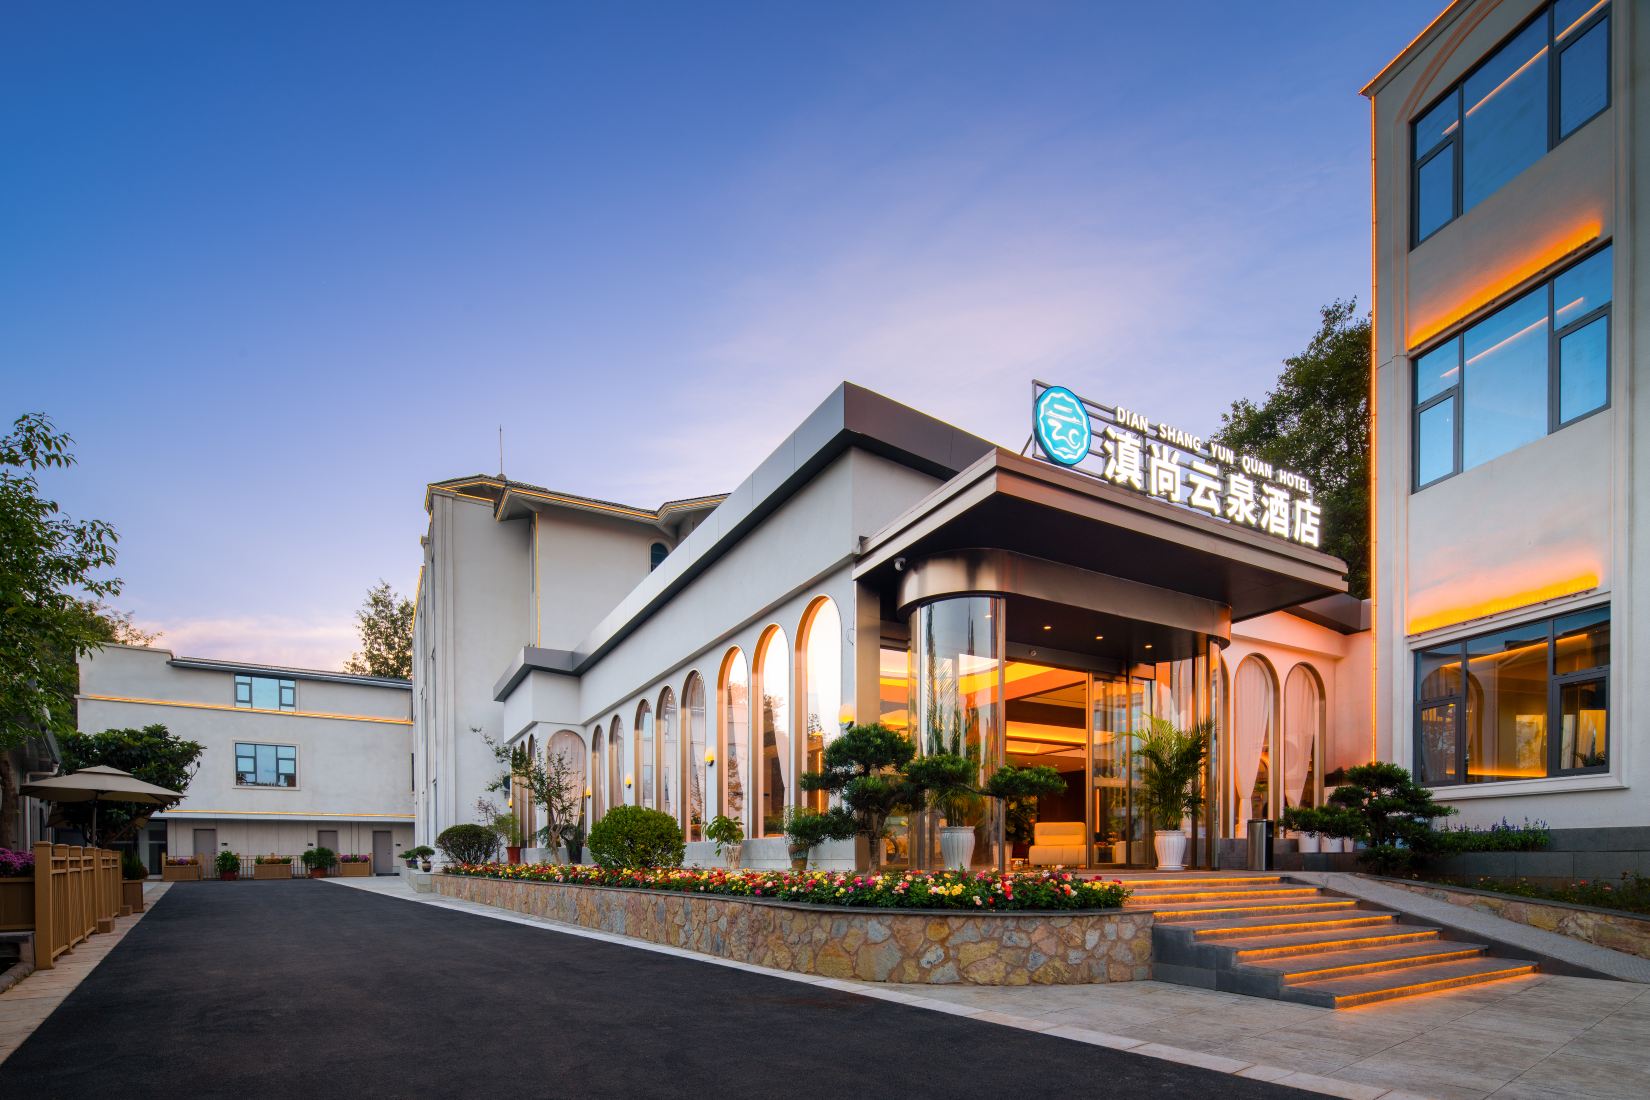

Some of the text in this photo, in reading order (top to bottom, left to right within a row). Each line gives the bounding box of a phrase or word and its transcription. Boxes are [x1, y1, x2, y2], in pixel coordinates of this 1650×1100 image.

[1102, 426, 1321, 547] 滇尚云泉酒店
[1116, 406, 1311, 493] DIAN SHANG YUN QUAN HOTEL
